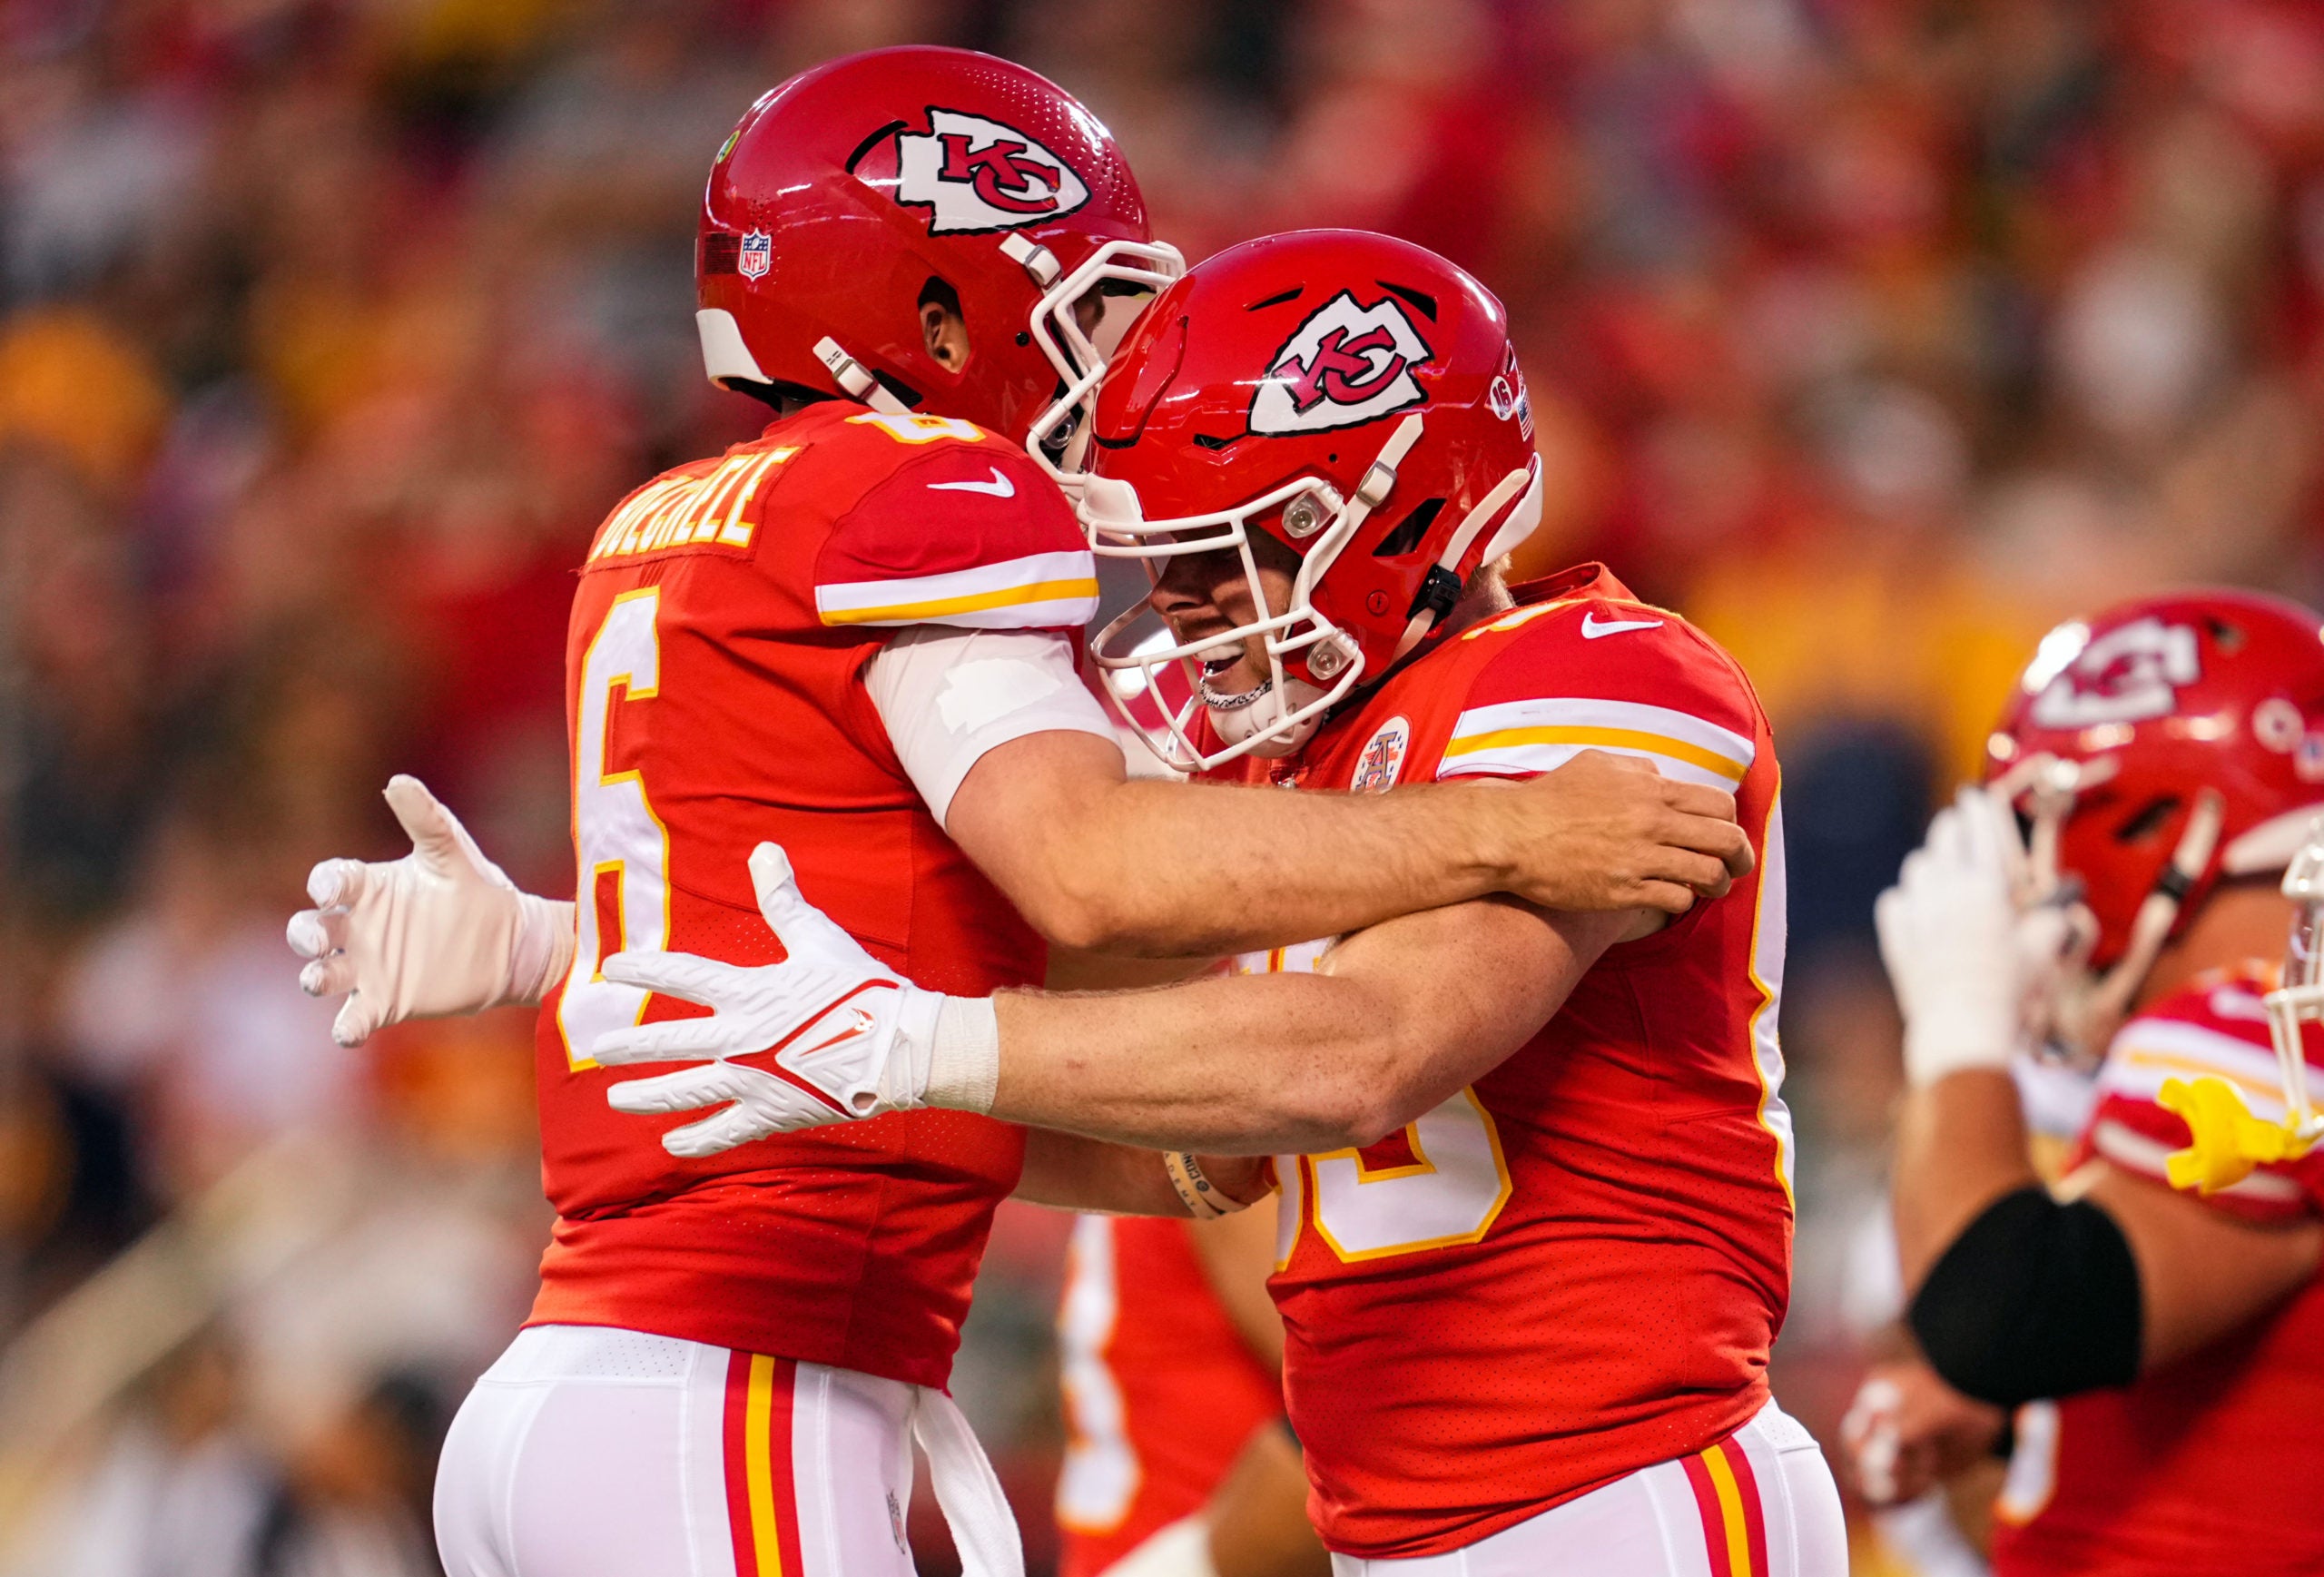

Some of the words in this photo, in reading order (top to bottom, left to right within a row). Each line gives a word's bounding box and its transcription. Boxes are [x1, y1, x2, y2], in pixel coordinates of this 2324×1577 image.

[937, 133, 1060, 214] KC
[743, 251, 765, 271] NFL
[1272, 324, 1407, 417] KC
[1492, 380, 1512, 418] 16
[557, 586, 671, 1072] 6
[1183, 1152, 1200, 1179] CON
